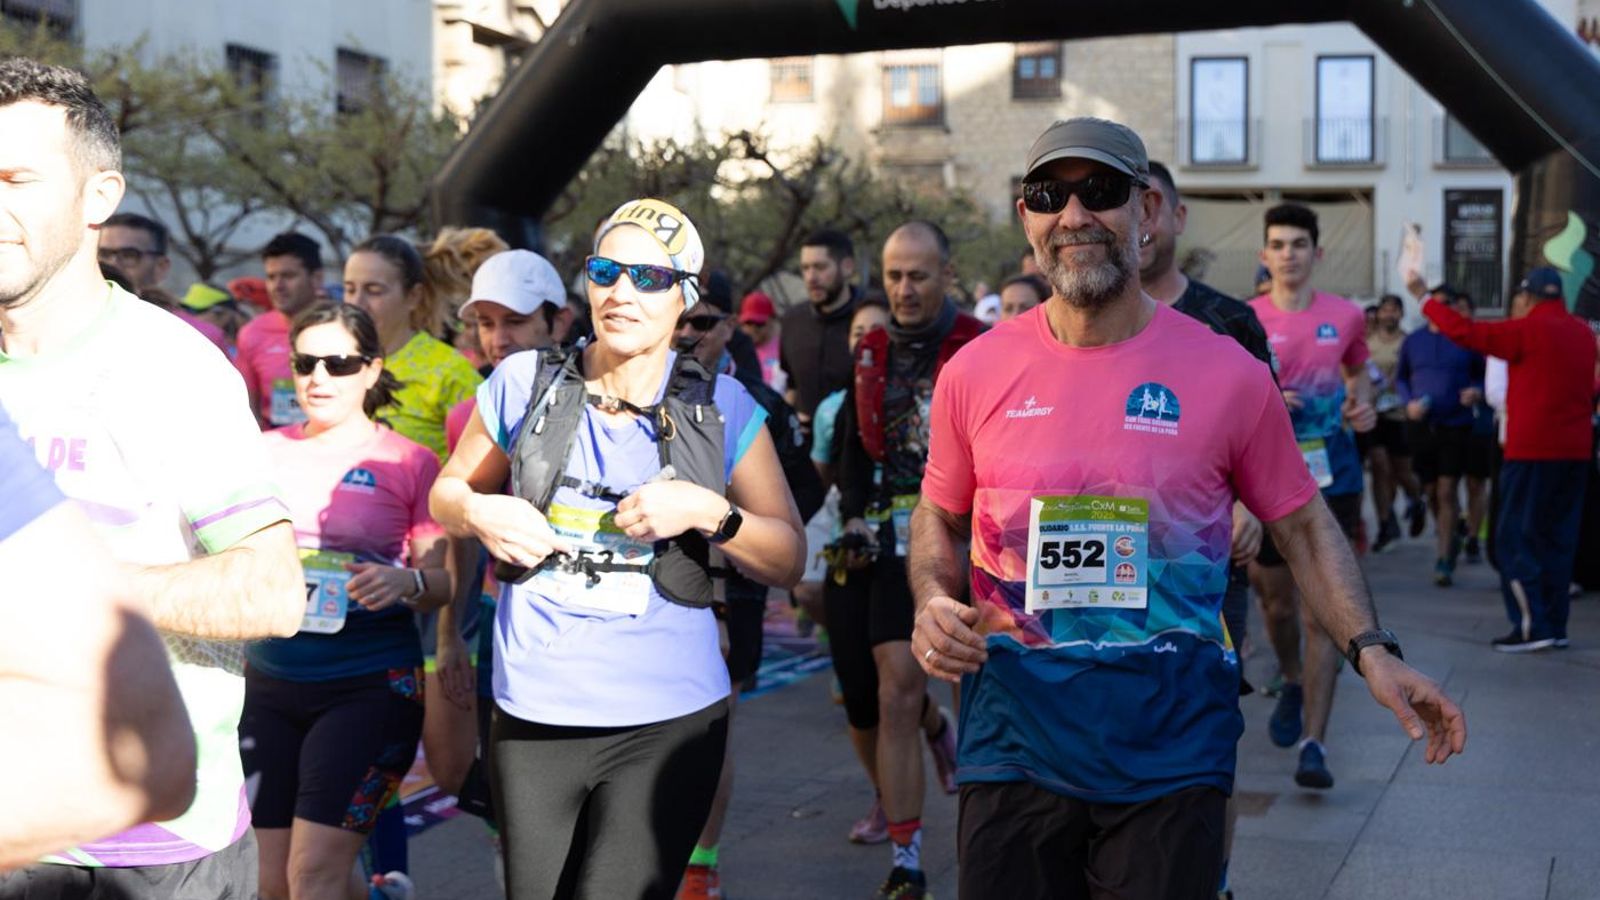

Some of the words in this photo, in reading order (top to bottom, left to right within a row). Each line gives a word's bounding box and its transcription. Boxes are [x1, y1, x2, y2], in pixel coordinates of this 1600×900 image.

[873, 0, 967, 11] Depo
[1091, 500, 1115, 512] CxM
[1088, 524, 1114, 532] FUENTE
[1115, 524, 1126, 532] LA
[1040, 540, 1105, 570] 552
